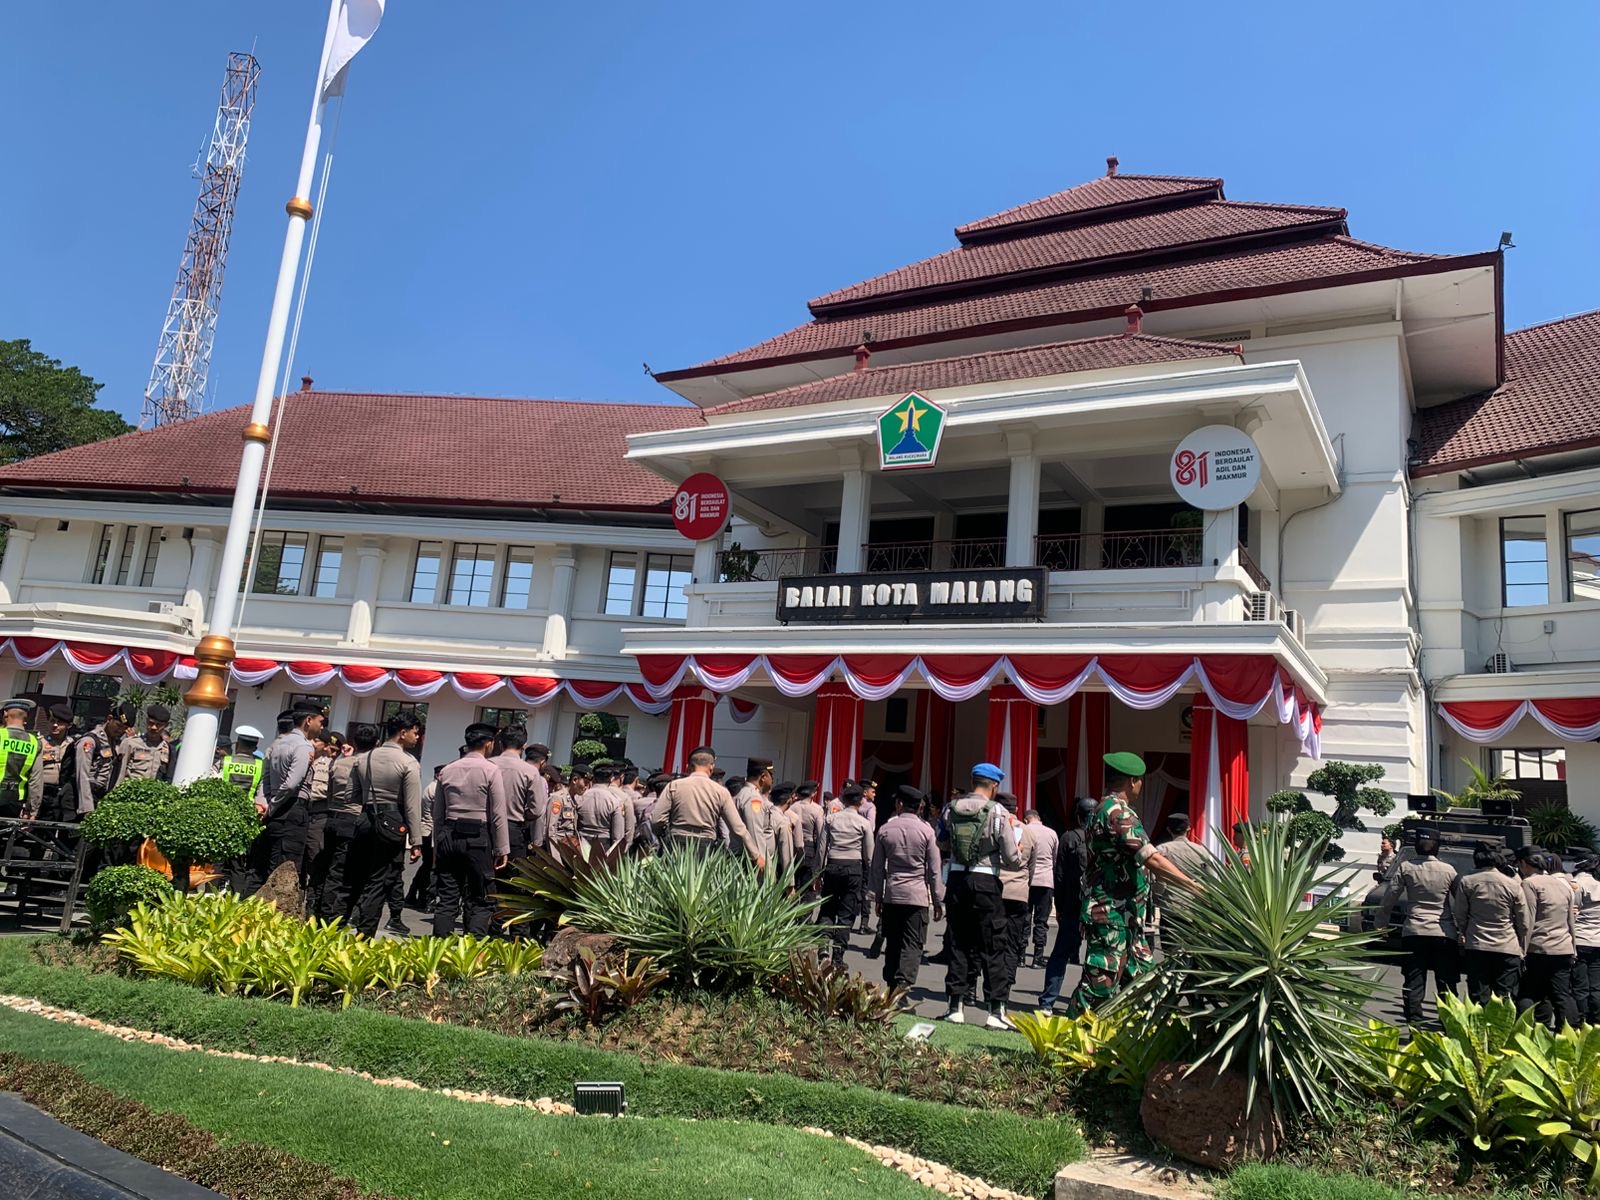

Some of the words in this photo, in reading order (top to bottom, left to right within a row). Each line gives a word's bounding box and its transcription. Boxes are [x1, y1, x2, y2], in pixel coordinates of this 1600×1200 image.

[1214, 447, 1251, 457] INDONESIA
[1215, 455, 1254, 465] BERDAULAT
[1175, 450, 1210, 488] 81
[1232, 464, 1247, 472] DAN
[1216, 472, 1248, 481] MAKMUR
[675, 491, 699, 523] 81
[785, 585, 851, 608] BALAI
[861, 582, 919, 606] KOTA
[930, 578, 1033, 605] MALANG
[3, 740, 35, 755] POLISI
[228, 763, 257, 775] POLISI
